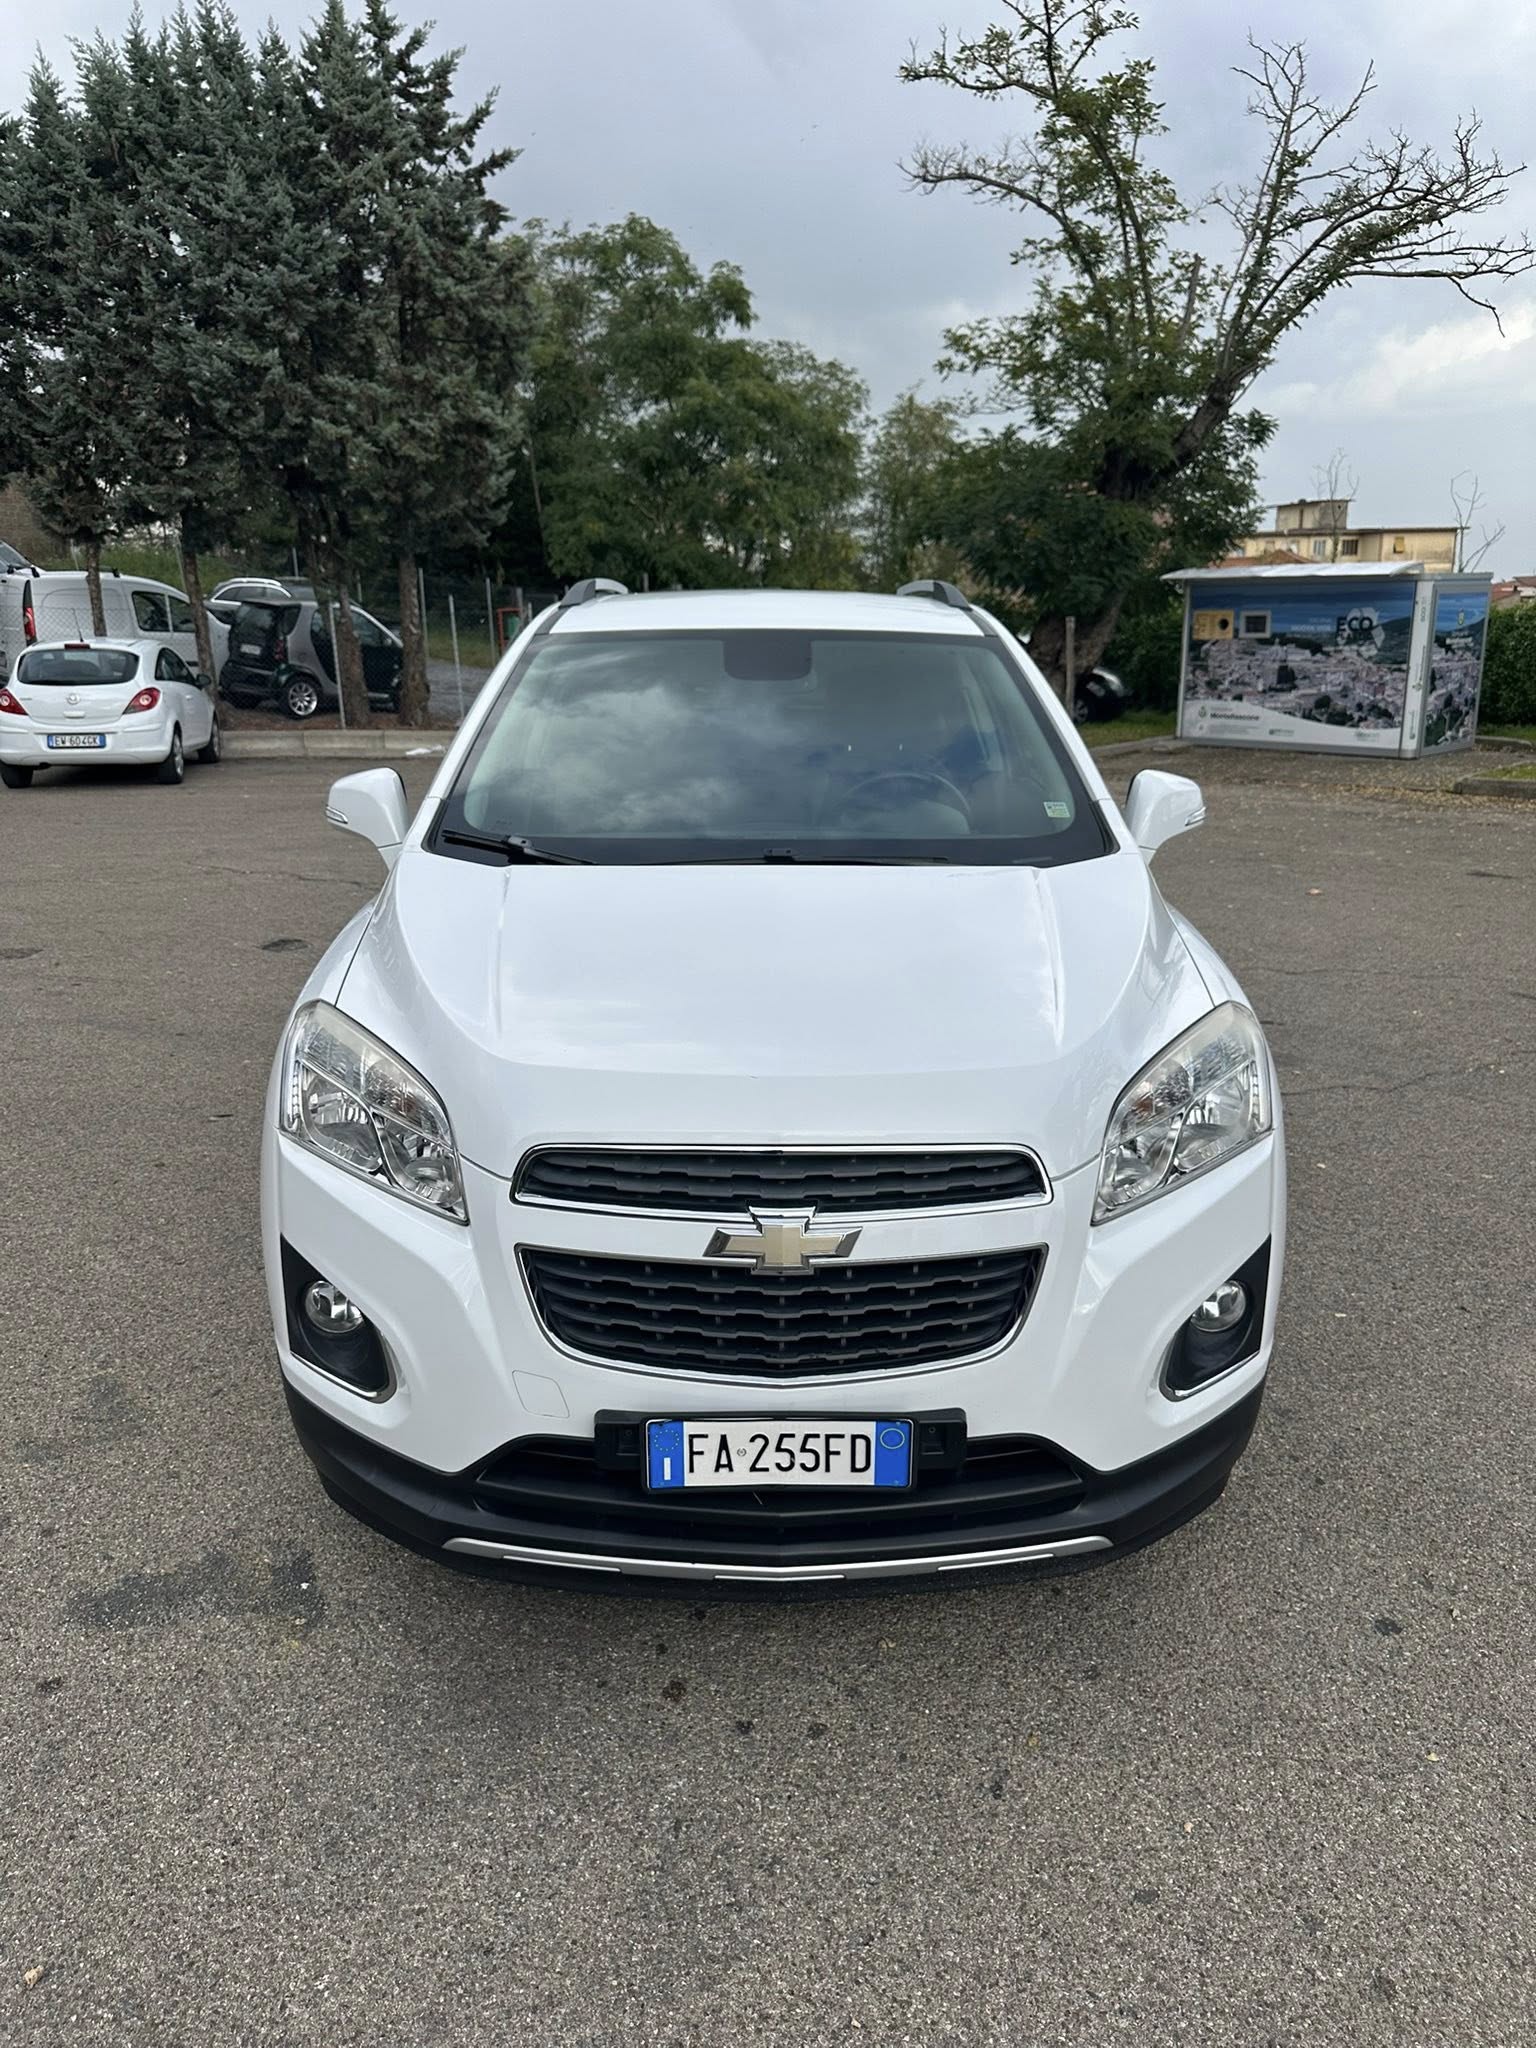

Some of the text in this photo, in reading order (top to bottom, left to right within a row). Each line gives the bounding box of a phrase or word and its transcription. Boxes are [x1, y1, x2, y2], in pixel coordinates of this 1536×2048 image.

[1336, 616, 1373, 632] ECO
[687, 1433, 734, 1474] FA
[748, 1433, 872, 1474] 255FD
